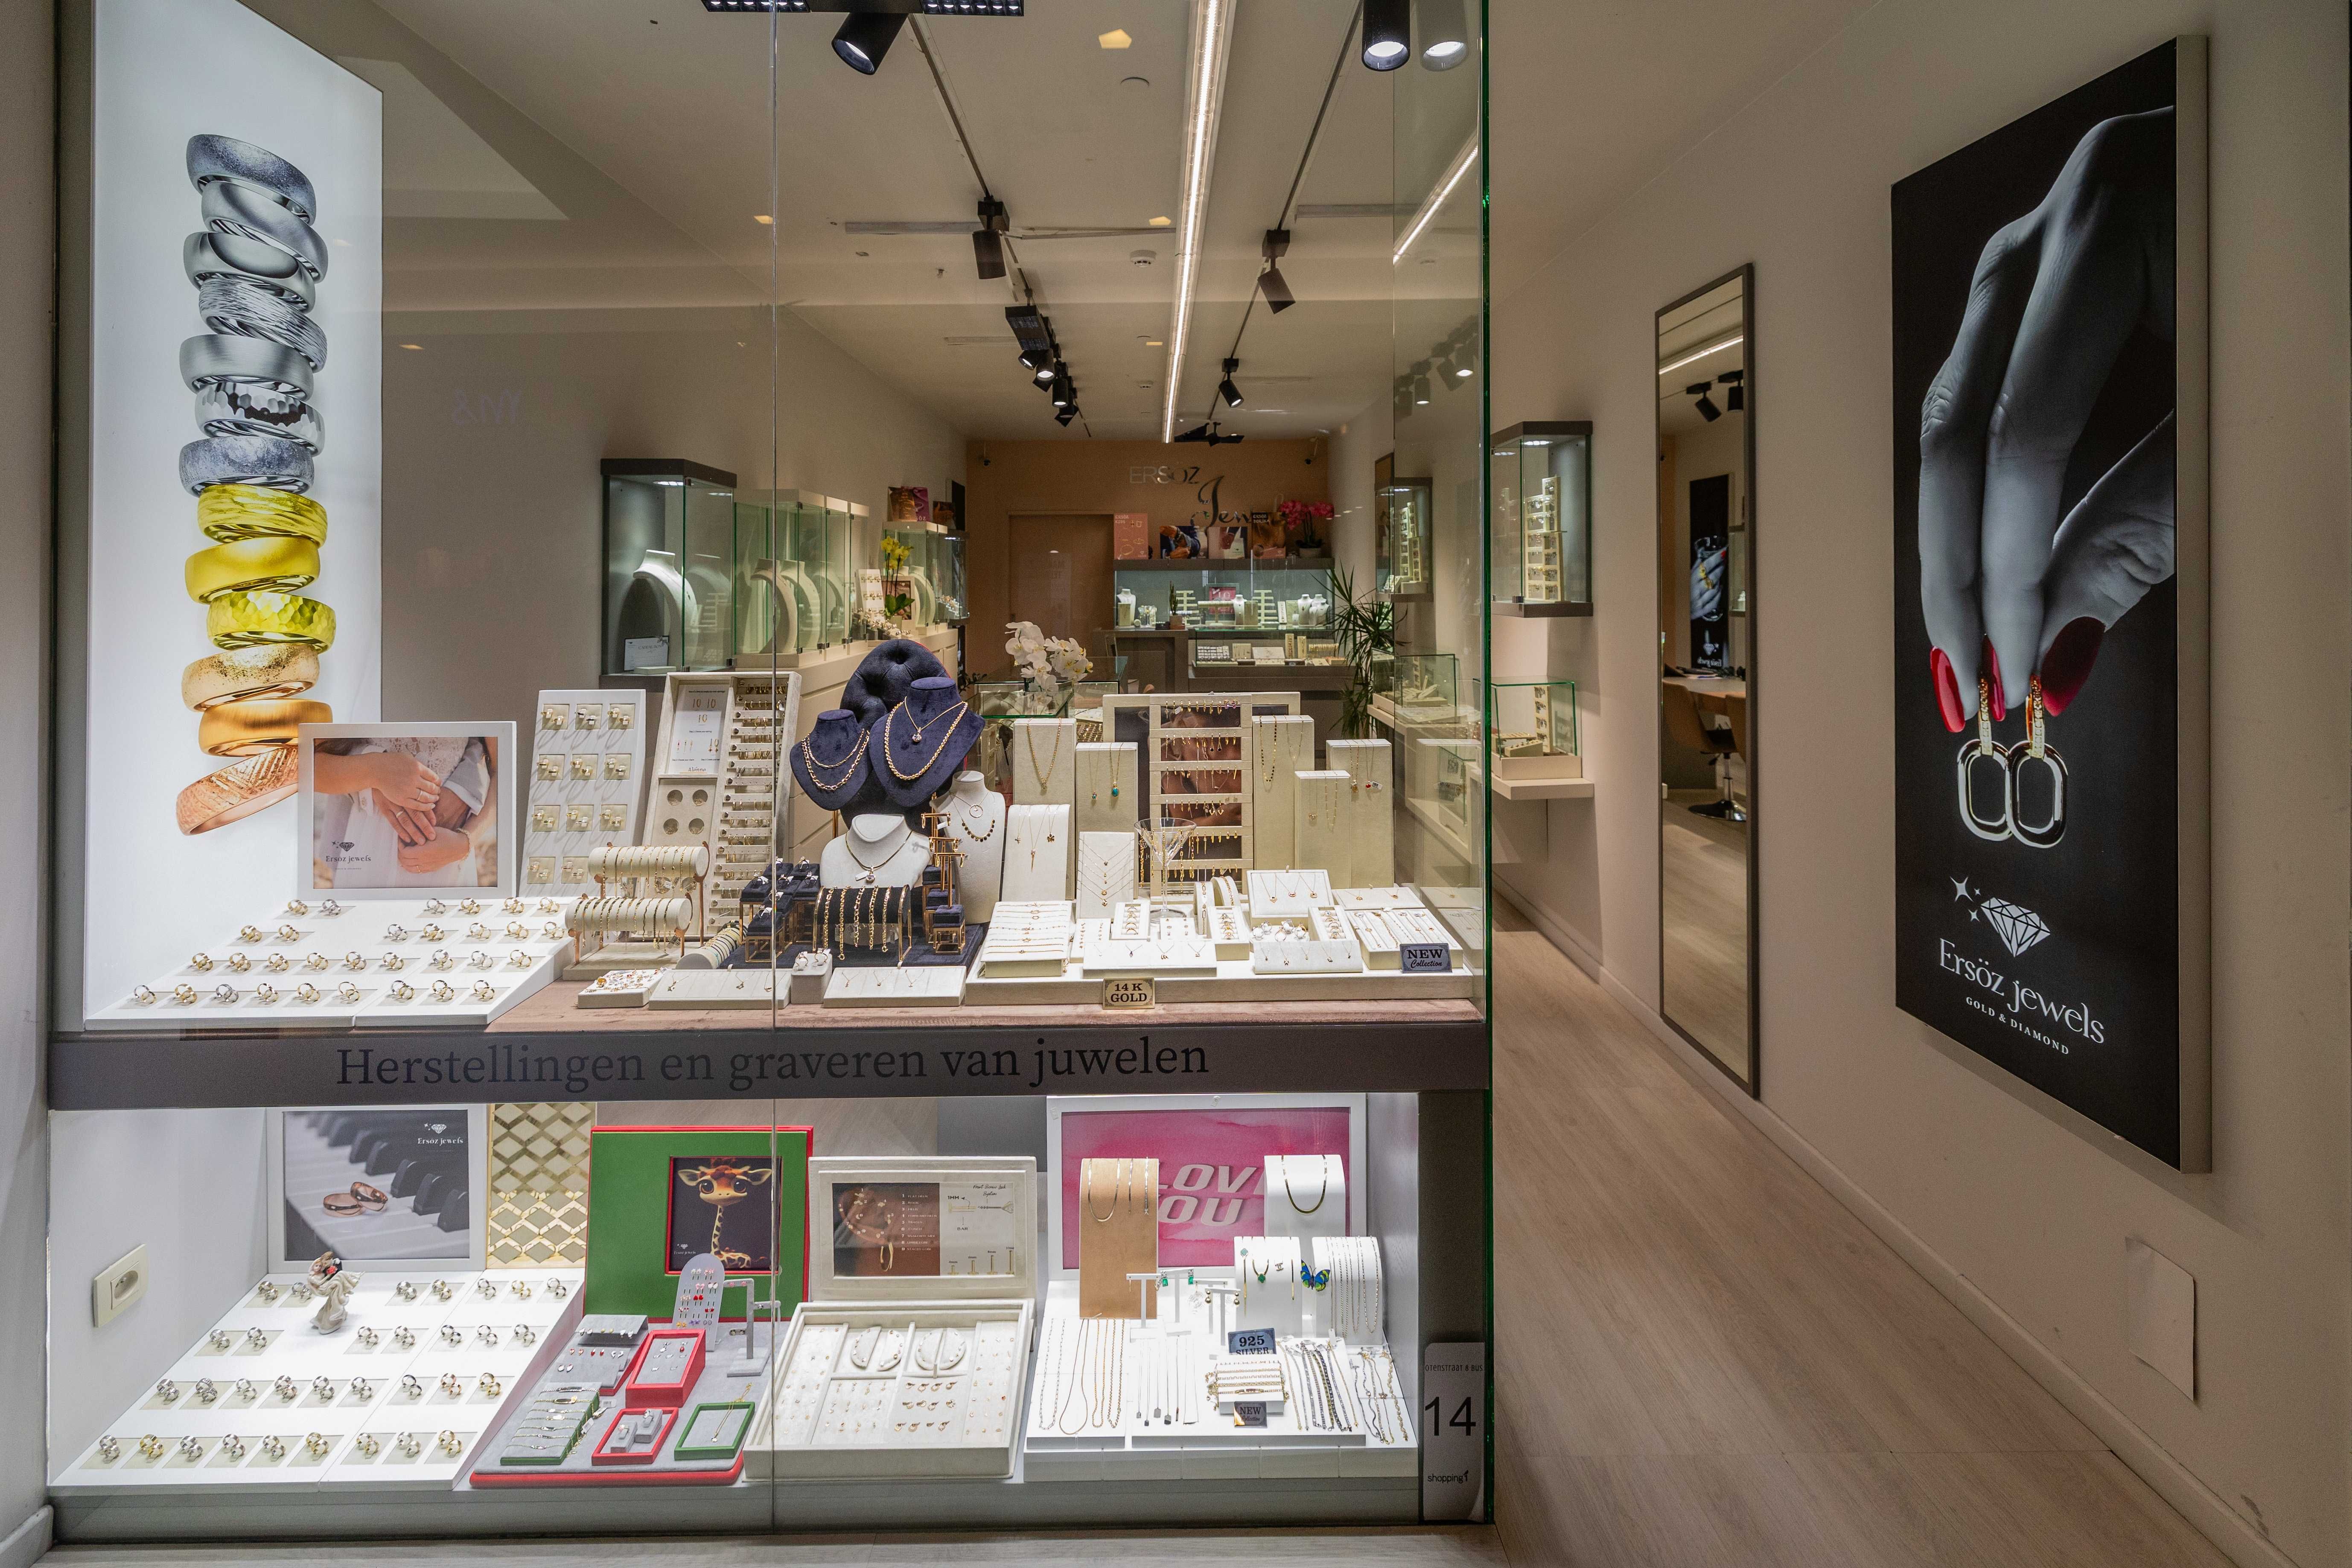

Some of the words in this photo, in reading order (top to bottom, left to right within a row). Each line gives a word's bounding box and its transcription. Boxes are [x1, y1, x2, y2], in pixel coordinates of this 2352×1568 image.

[1190, 475, 1252, 536] Jew
[1407, 949, 1443, 959] NEW
[1411, 959, 1442, 968] Collection
[1110, 993, 1147, 1003] GOLD
[1940, 938, 2004, 996] Ersöz
[2007, 980, 2104, 1043] jewels
[1966, 997, 1995, 1016] GOLD
[1999, 1014, 2006, 1023] &
[2011, 1019, 2069, 1055] DIAMOND
[336, 1044, 647, 1093] Herstellingen
[660, 1054, 715, 1081] en
[729, 1051, 928, 1092] graveren
[942, 1049, 1021, 1076] van
[1029, 1035, 1210, 1088] juwelen
[1158, 1193, 1244, 1227] OU
[1239, 1335, 1265, 1347] 925
[1240, 1406, 1261, 1415] NEW
[1424, 1396, 1476, 1436] 14
